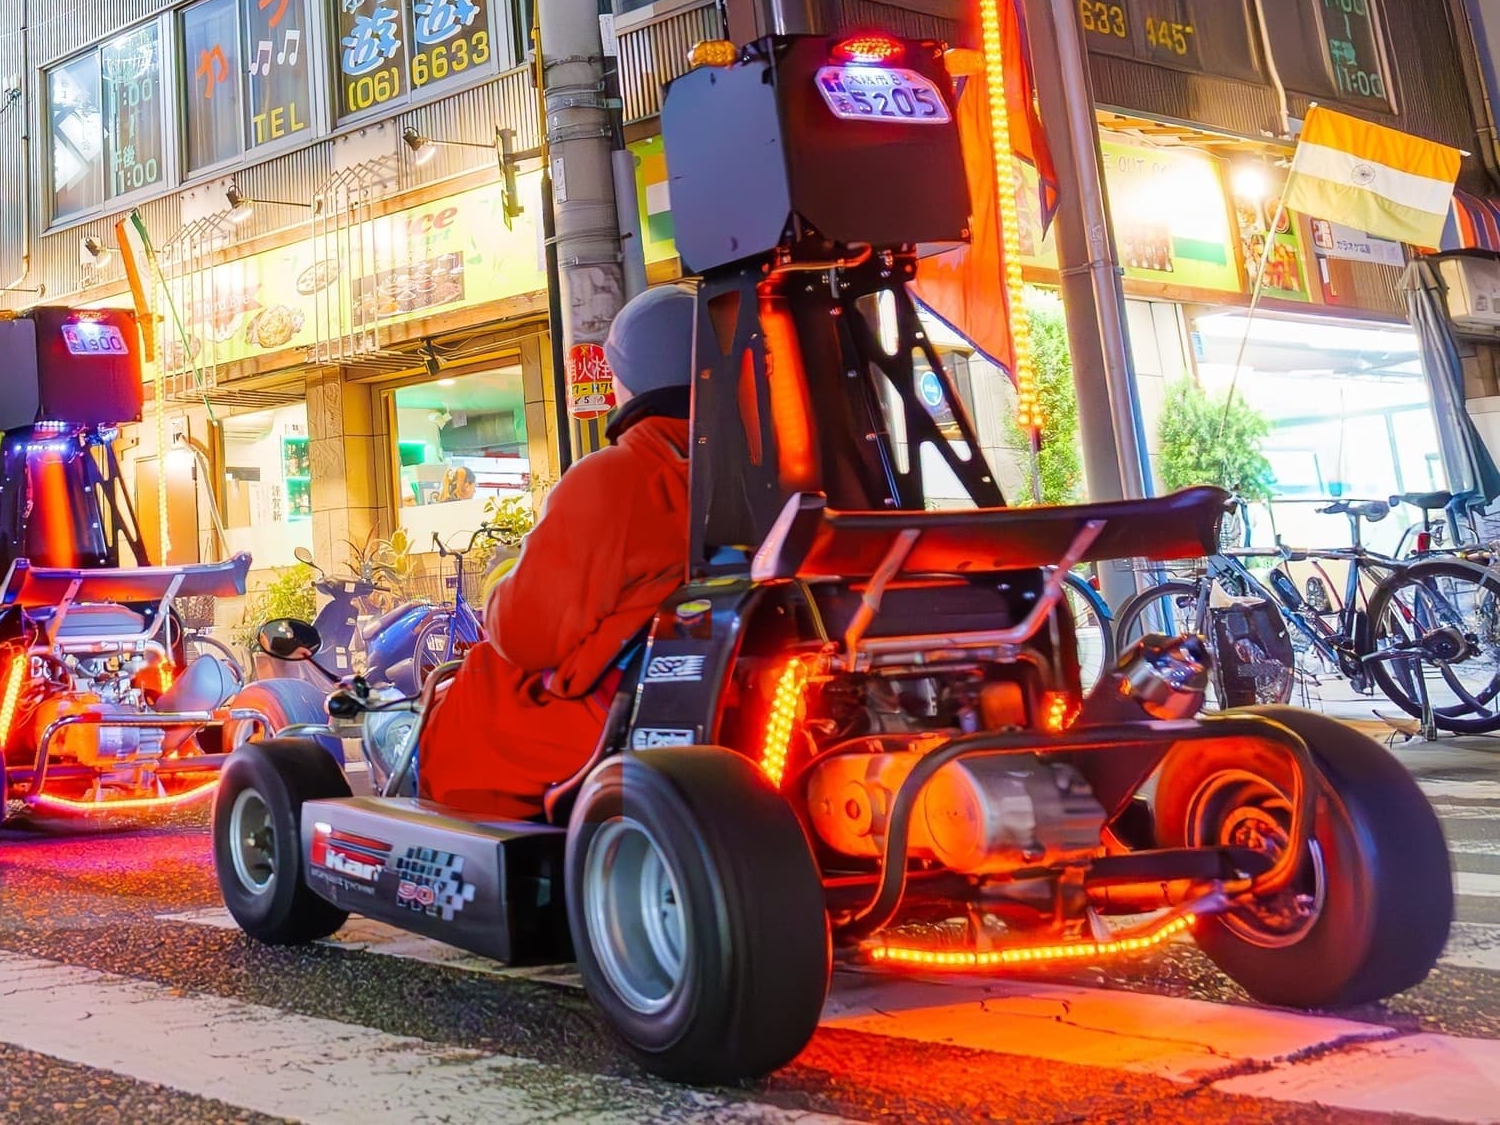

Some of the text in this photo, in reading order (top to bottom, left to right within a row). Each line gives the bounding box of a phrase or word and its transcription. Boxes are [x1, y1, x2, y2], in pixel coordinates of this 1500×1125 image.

[253, 30, 490, 145] TEL (06) 6633
[849, 87, 938, 117] 5205
